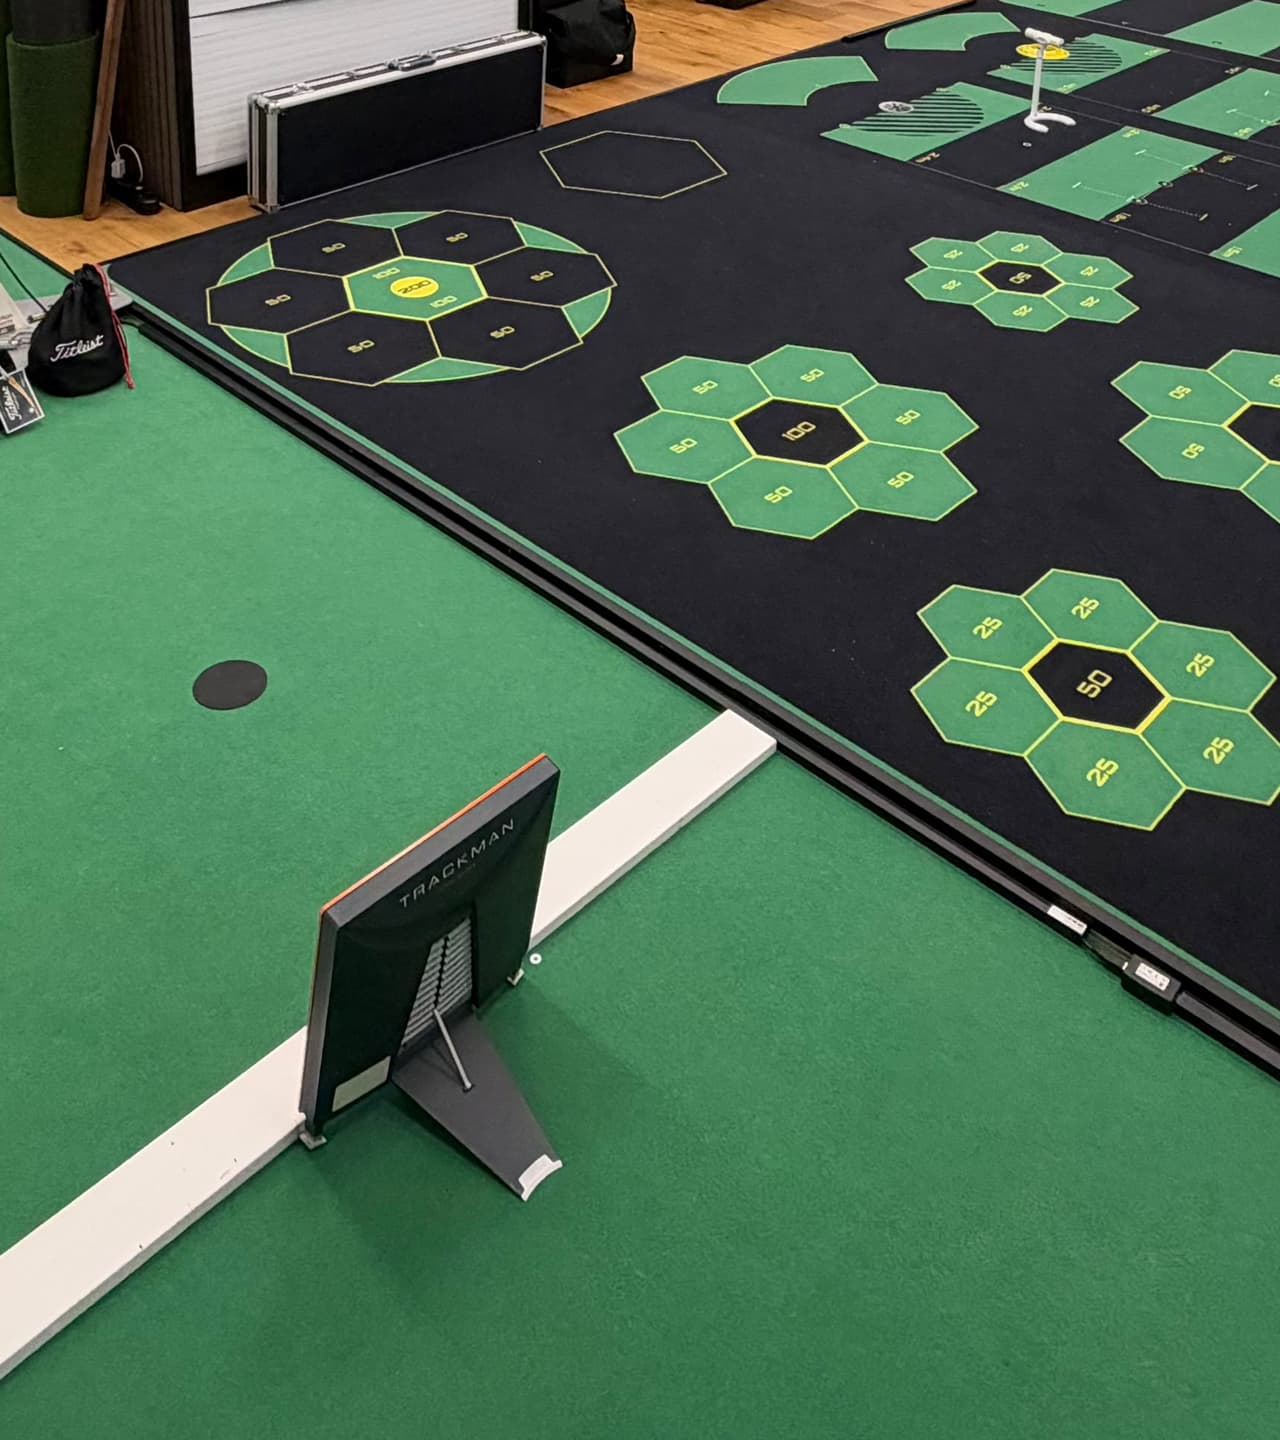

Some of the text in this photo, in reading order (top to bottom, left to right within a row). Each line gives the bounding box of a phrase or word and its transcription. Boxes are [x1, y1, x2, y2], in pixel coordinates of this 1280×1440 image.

[446, 233, 468, 242] 50
[322, 243, 345, 253] 50
[373, 268, 400, 279] 100
[531, 271, 553, 281] 50
[398, 281, 431, 294] 200
[265, 295, 291, 305] 50
[430, 296, 457, 308] 100
[490, 326, 514, 338] 50
[50, 334, 104, 362] Titleist
[348, 340, 374, 352] 50
[800, 369, 824, 382] 50
[693, 381, 718, 394] 50
[1169, 386, 1192, 399] 50
[896, 410, 920, 424] 50
[782, 422, 816, 440] 100
[670, 438, 697, 453] 50
[1182, 443, 1204, 458] 50
[888, 472, 914, 488] 50
[764, 486, 792, 503] 50
[1072, 597, 1099, 619] 25
[973, 617, 1002, 639] 25
[1186, 653, 1214, 677] 25
[1077, 670, 1112, 697] 50
[966, 691, 997, 716] 25
[1204, 737, 1234, 764] 25
[1087, 758, 1118, 786] 25
[398, 817, 516, 910] TRACKMAN
